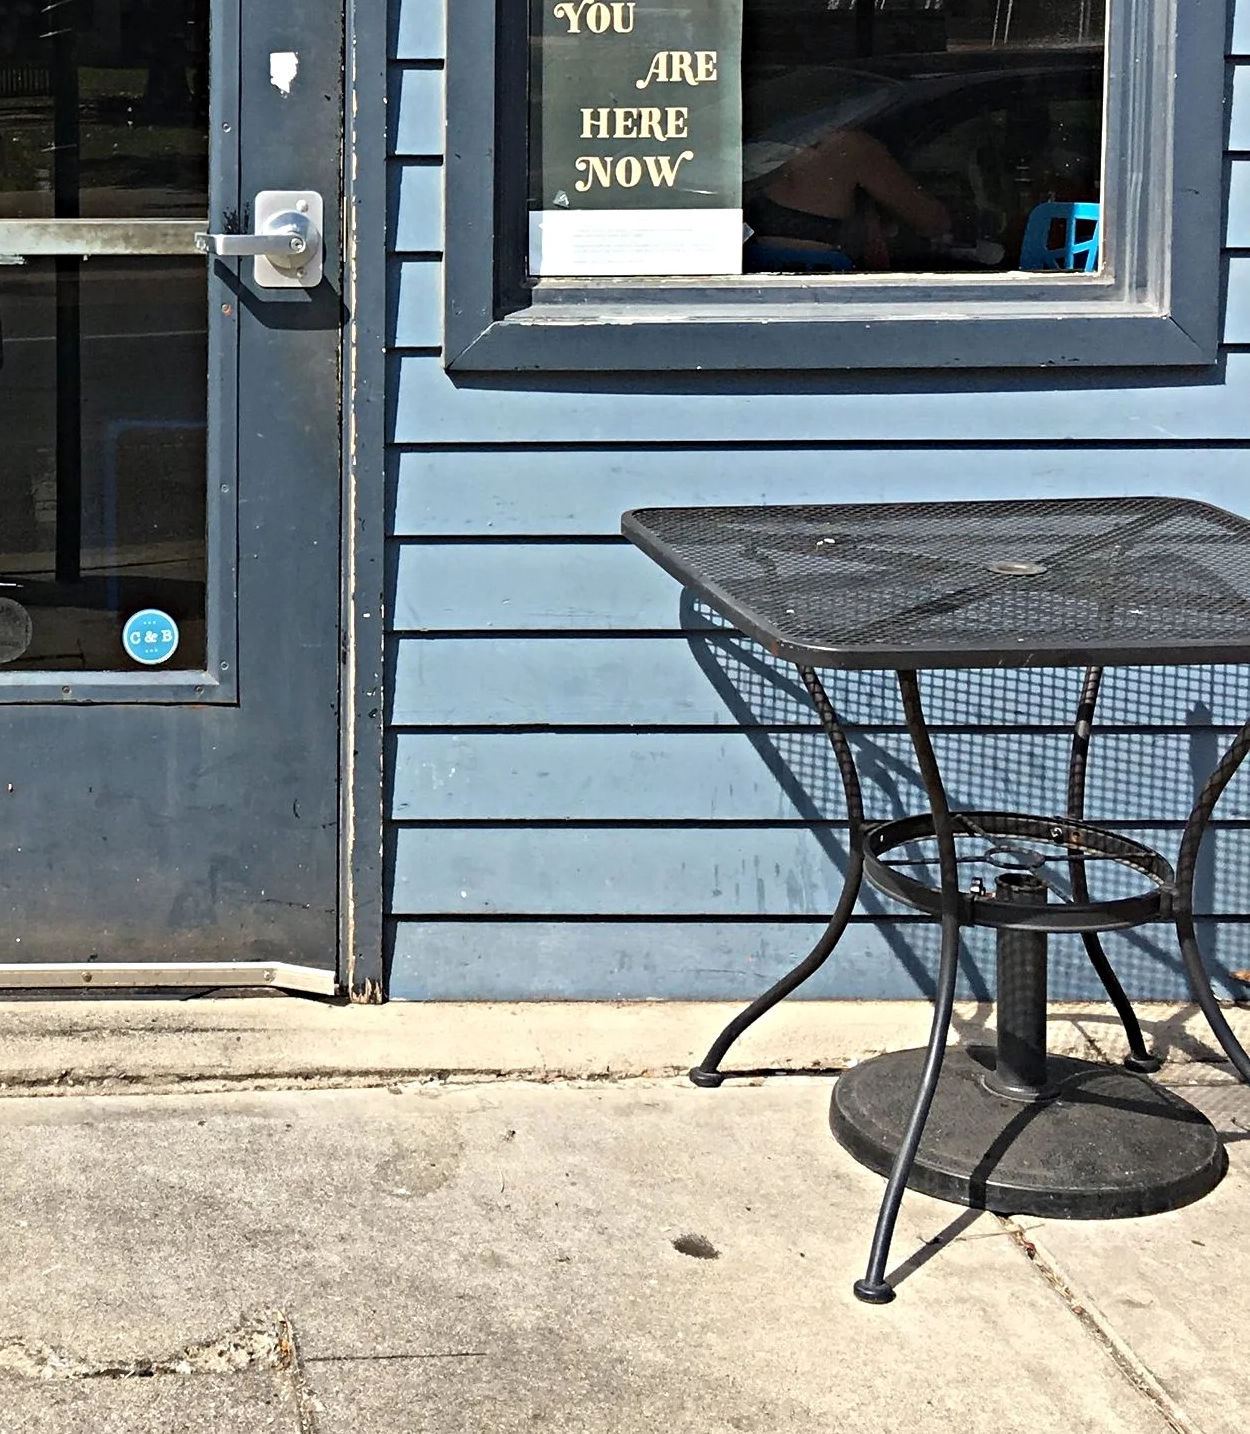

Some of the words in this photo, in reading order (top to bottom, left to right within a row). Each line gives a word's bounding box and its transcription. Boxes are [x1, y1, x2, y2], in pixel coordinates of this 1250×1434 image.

[635, 50, 718, 90] ARE
[579, 106, 688, 142] HERE
[574, 150, 694, 192] NOW
[130, 632, 141, 645] C
[161, 630, 174, 642] B
